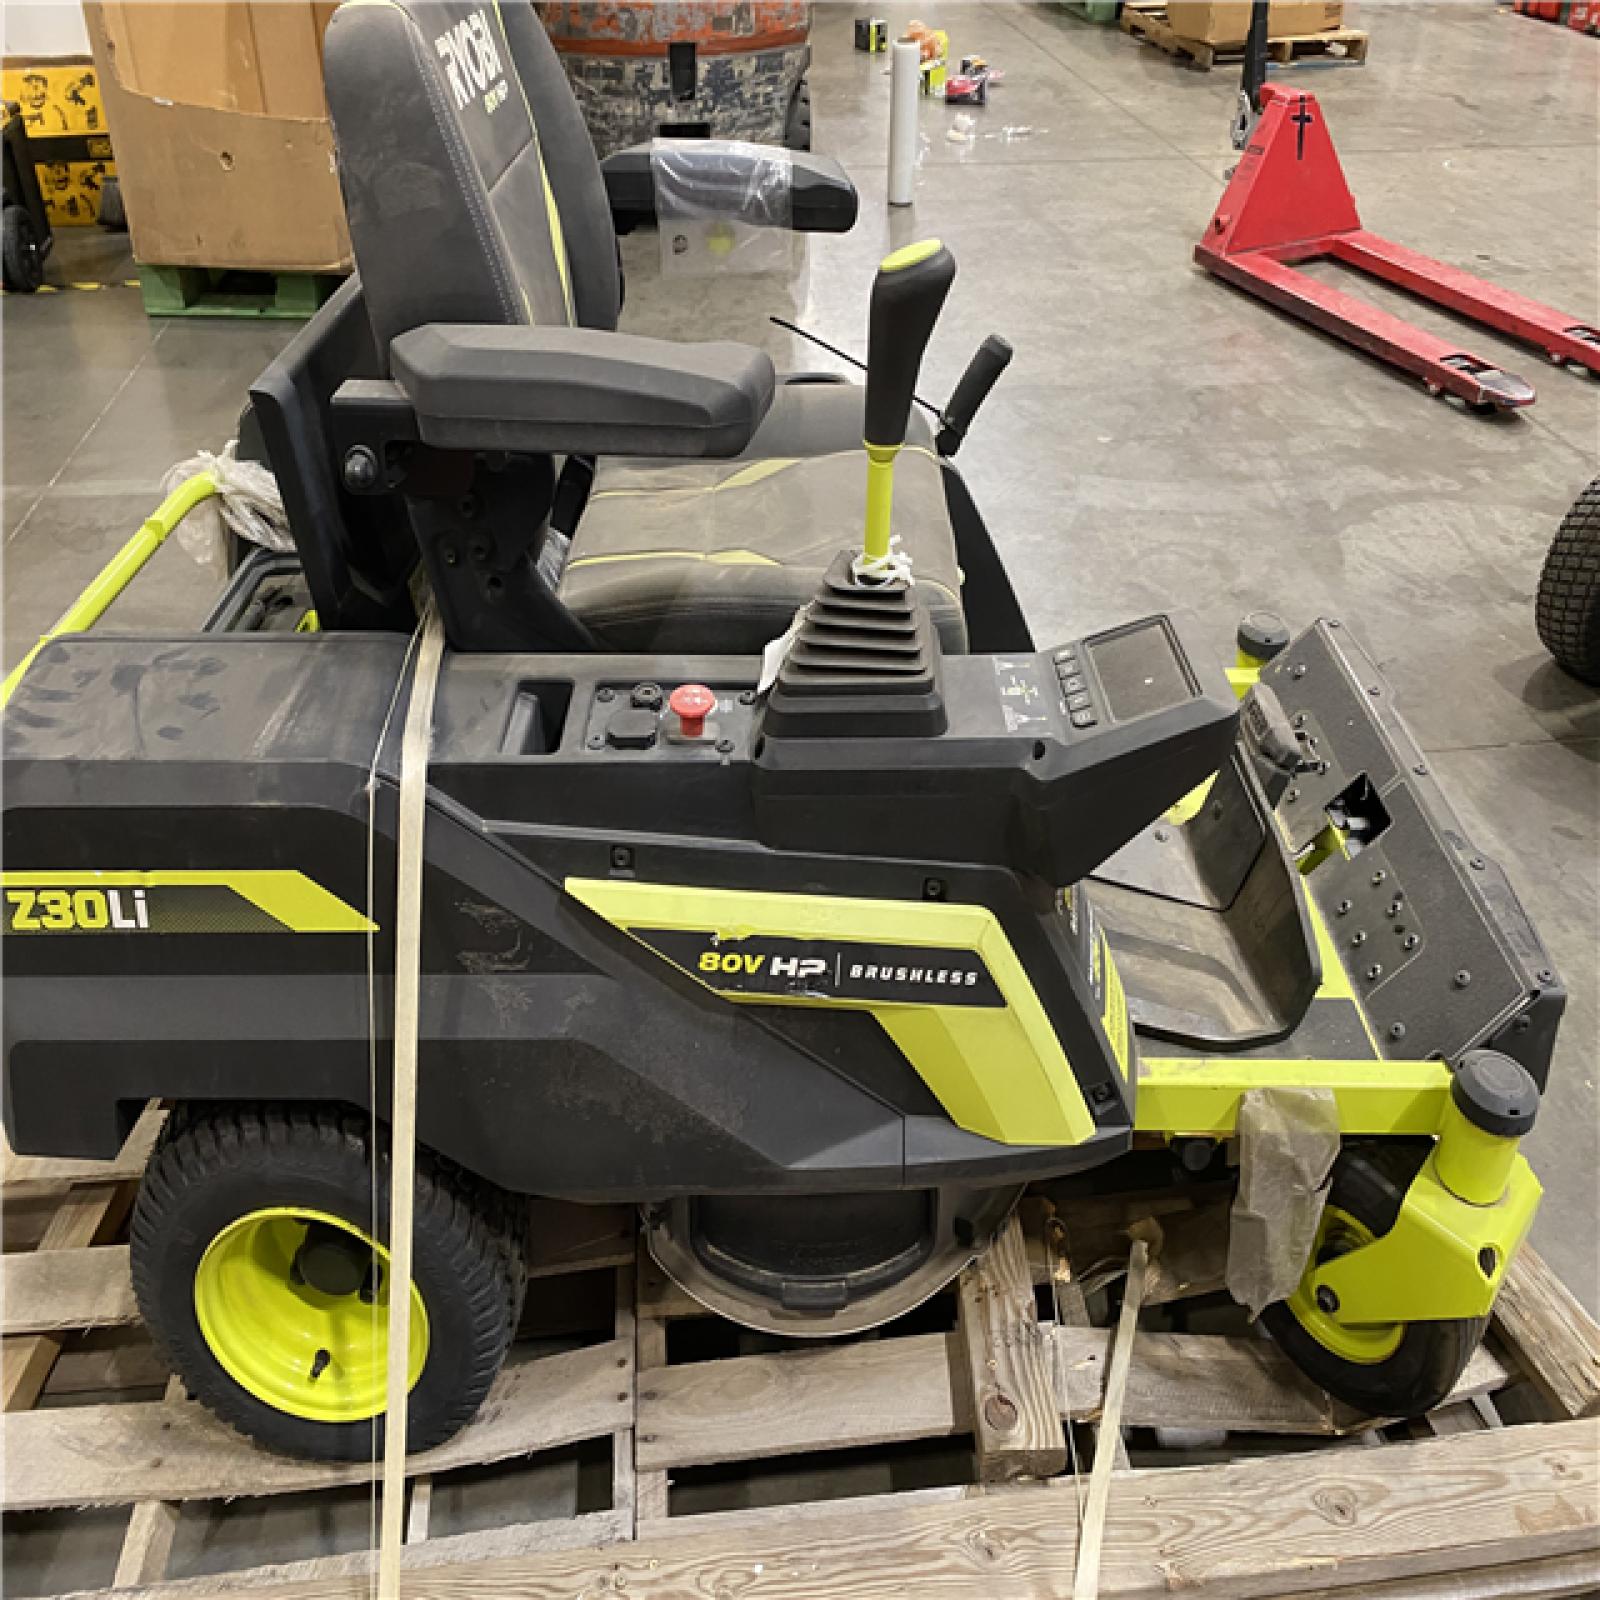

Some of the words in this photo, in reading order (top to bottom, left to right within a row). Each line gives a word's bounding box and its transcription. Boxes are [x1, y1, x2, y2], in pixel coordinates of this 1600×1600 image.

[435, 9, 503, 110] RYOBI
[6, 889, 149, 929] Z30Li
[698, 952, 766, 974] 80V
[769, 957, 826, 978] HP
[849, 964, 978, 986] BRUSHLESS
